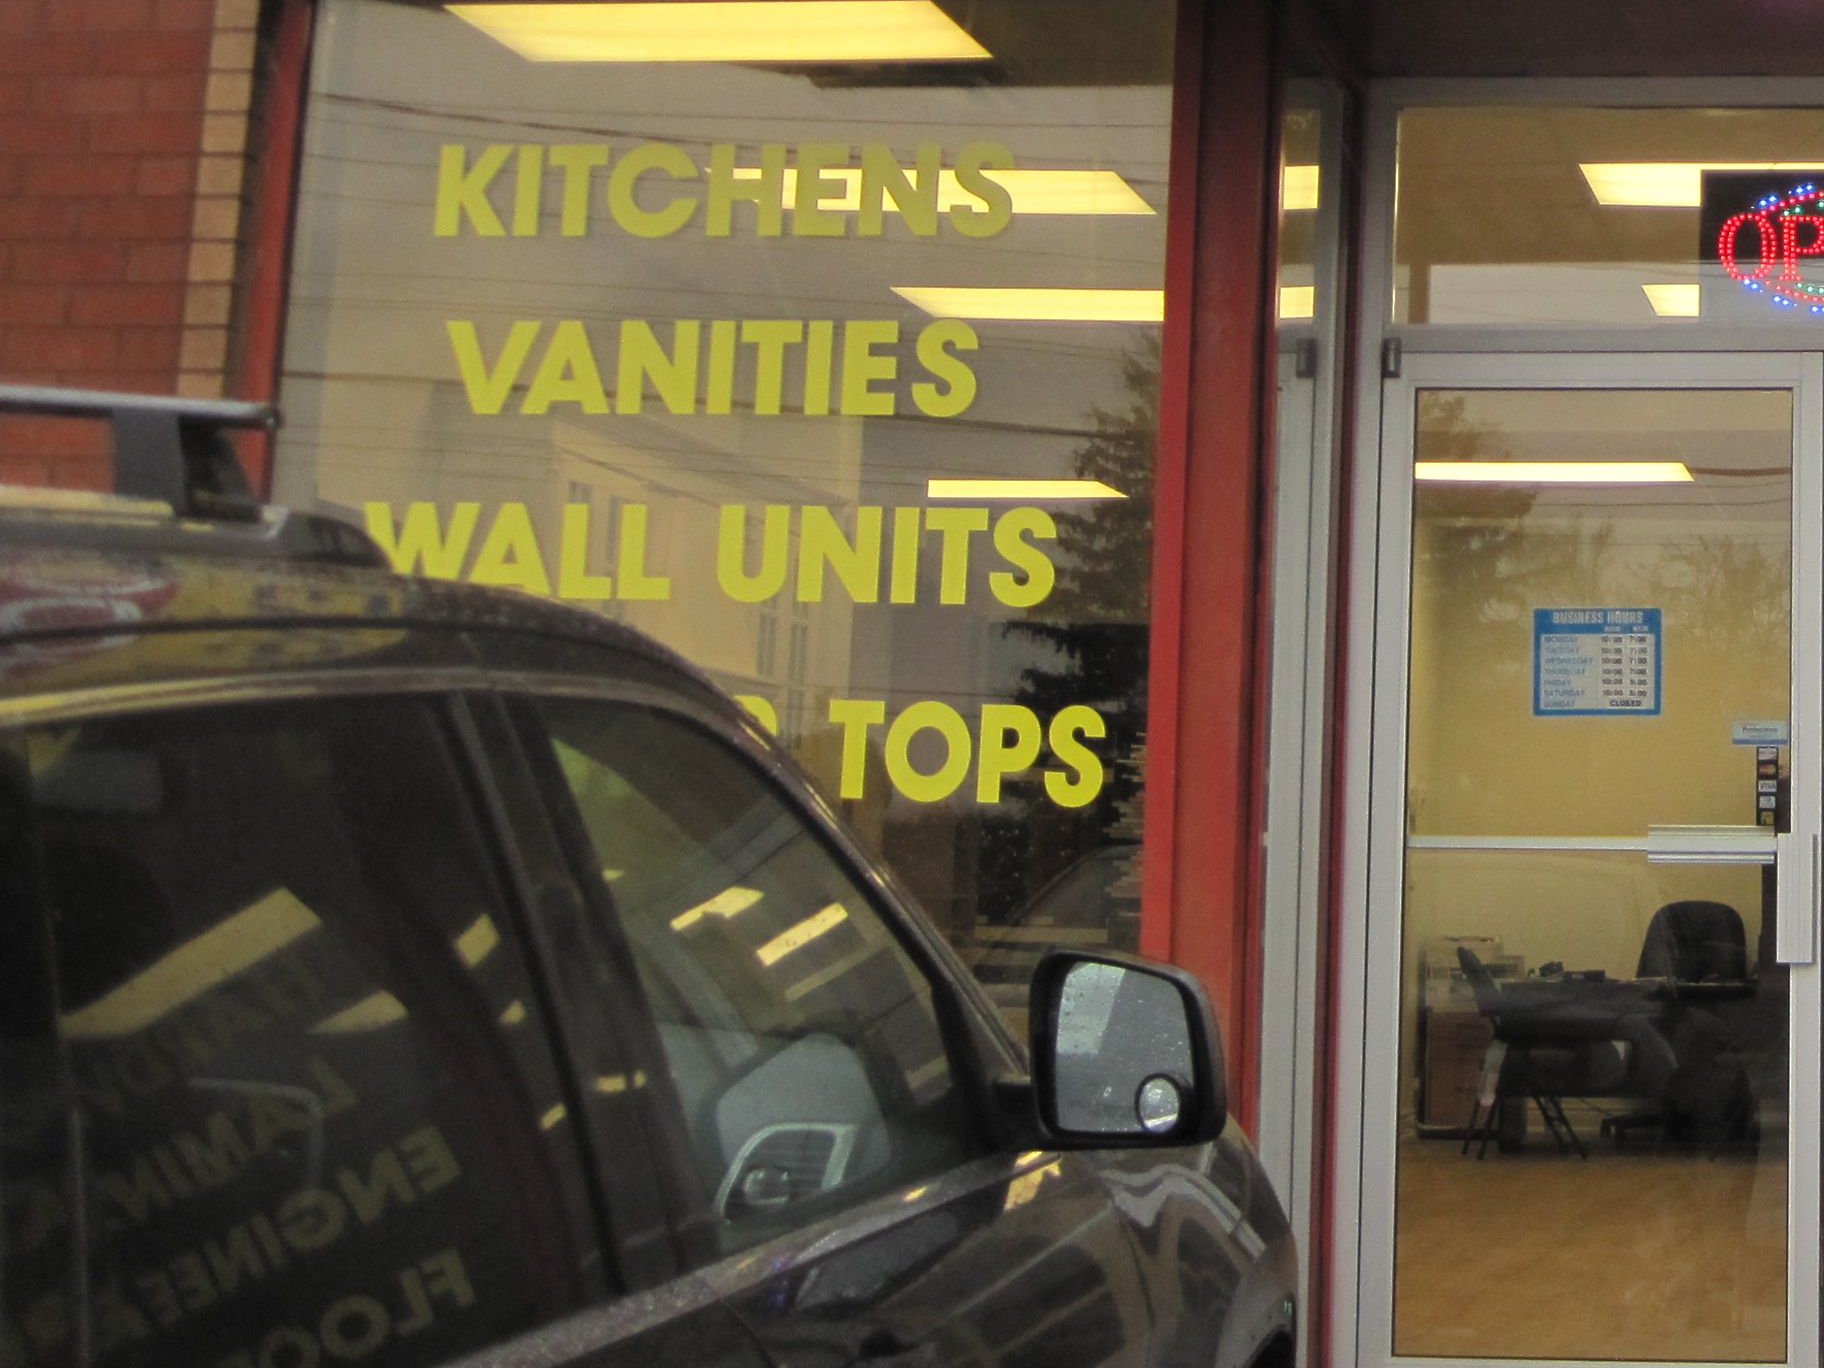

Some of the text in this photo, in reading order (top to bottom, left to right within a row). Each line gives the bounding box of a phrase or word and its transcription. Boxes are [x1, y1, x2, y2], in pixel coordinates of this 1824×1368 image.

[434, 143, 1014, 237] KITCHENS
[447, 320, 979, 417] VANITIES
[363, 500, 1057, 608] WALL UNITS
[1552, 611, 1643, 624] BUSINESS HOURS
[1610, 699, 1642, 707] CLOSED
[829, 699, 1107, 808] TOPS
